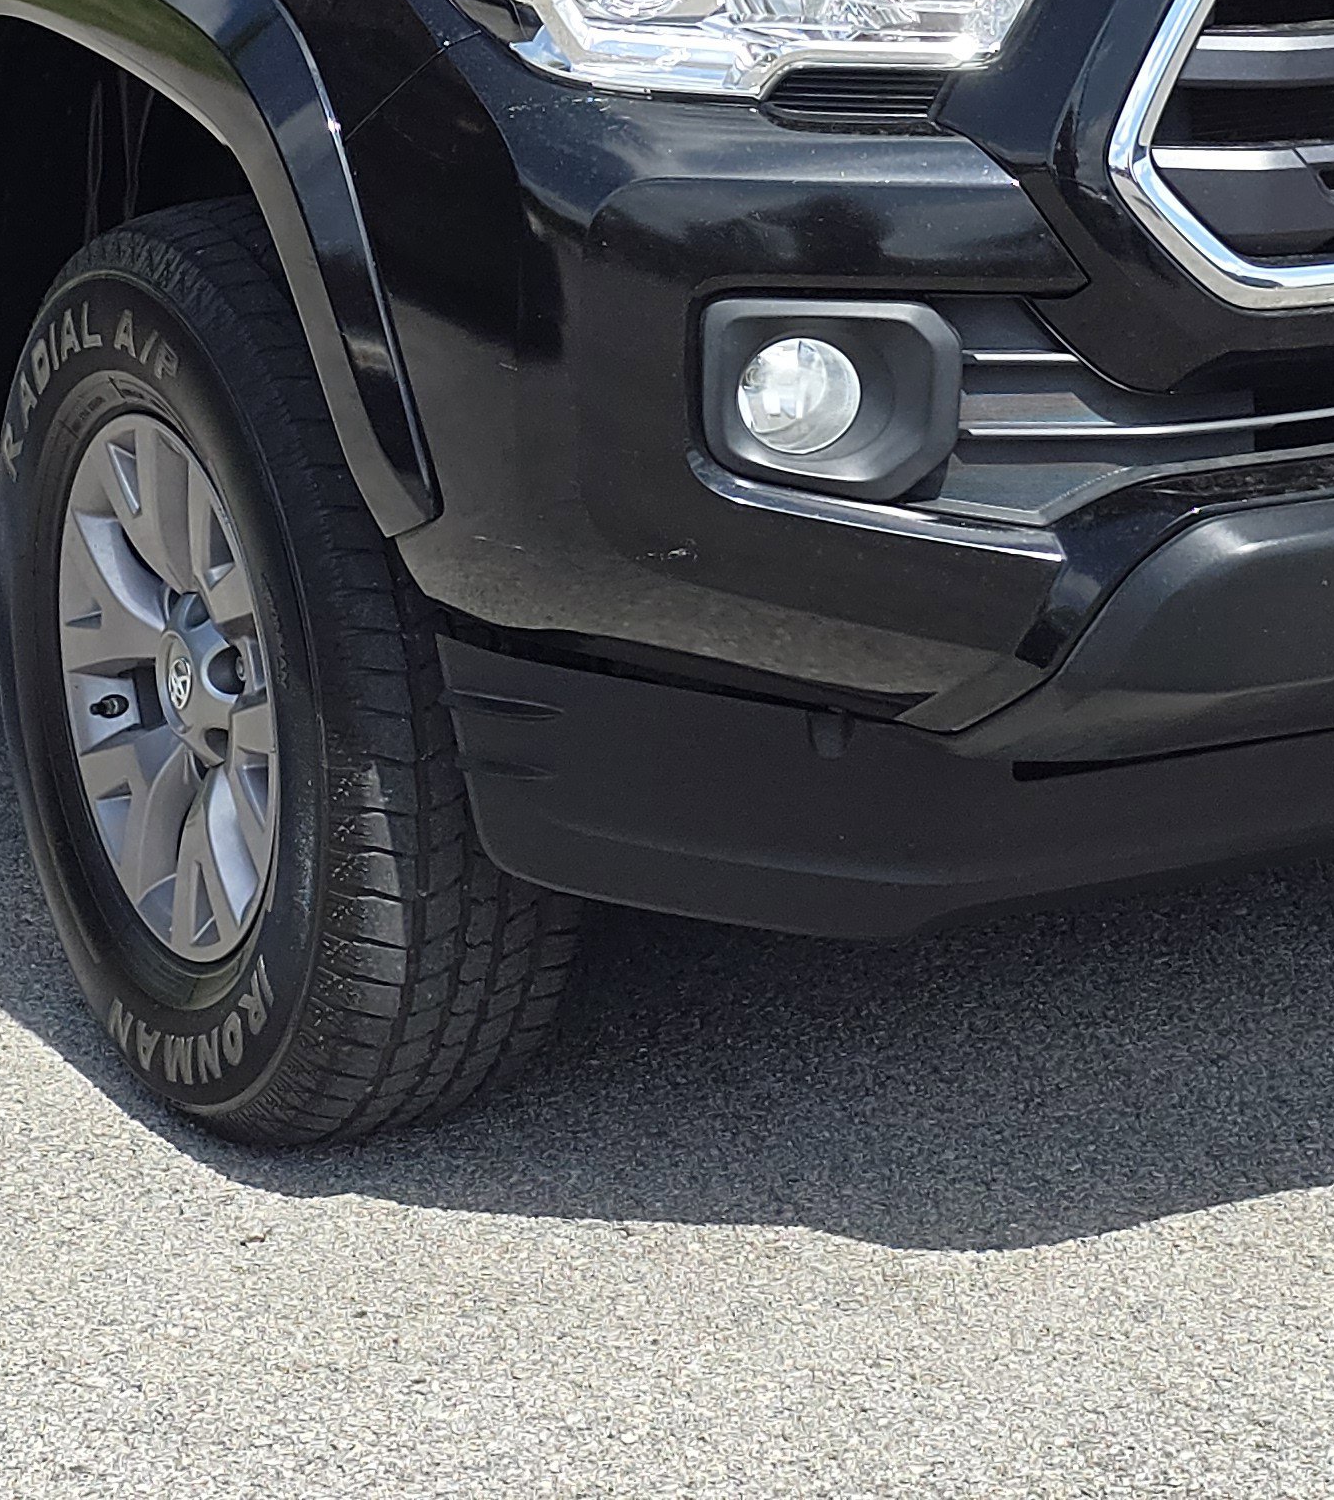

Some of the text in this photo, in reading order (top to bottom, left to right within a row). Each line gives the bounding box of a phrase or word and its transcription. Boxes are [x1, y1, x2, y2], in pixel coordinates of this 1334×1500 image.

[3, 300, 180, 484] RADIAL A/P
[107, 953, 275, 1085] IRONMAN
